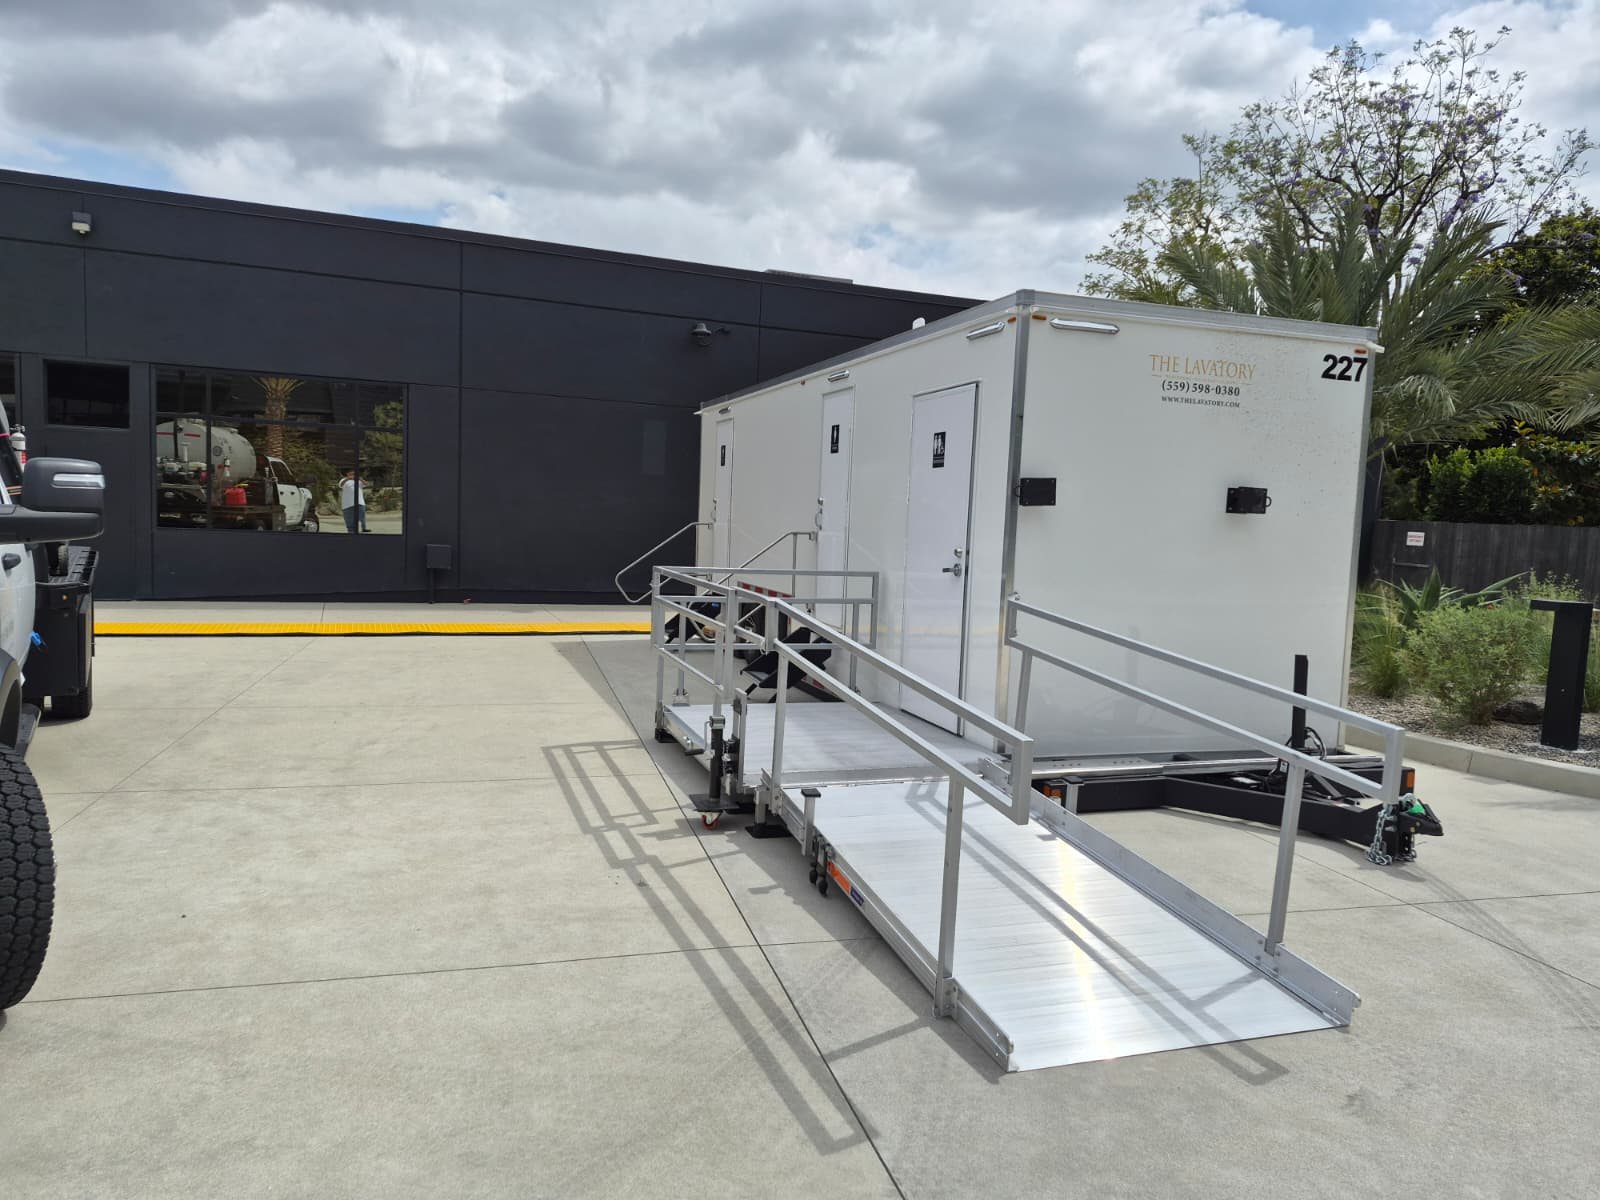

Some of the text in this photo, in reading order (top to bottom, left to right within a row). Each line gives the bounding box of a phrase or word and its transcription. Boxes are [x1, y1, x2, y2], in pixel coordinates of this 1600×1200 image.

[1149, 354, 1181, 373] THE
[1185, 357, 1257, 380] LAVATORY
[1321, 354, 1369, 382] 227
[1161, 380, 1240, 397] (559) 598-0380
